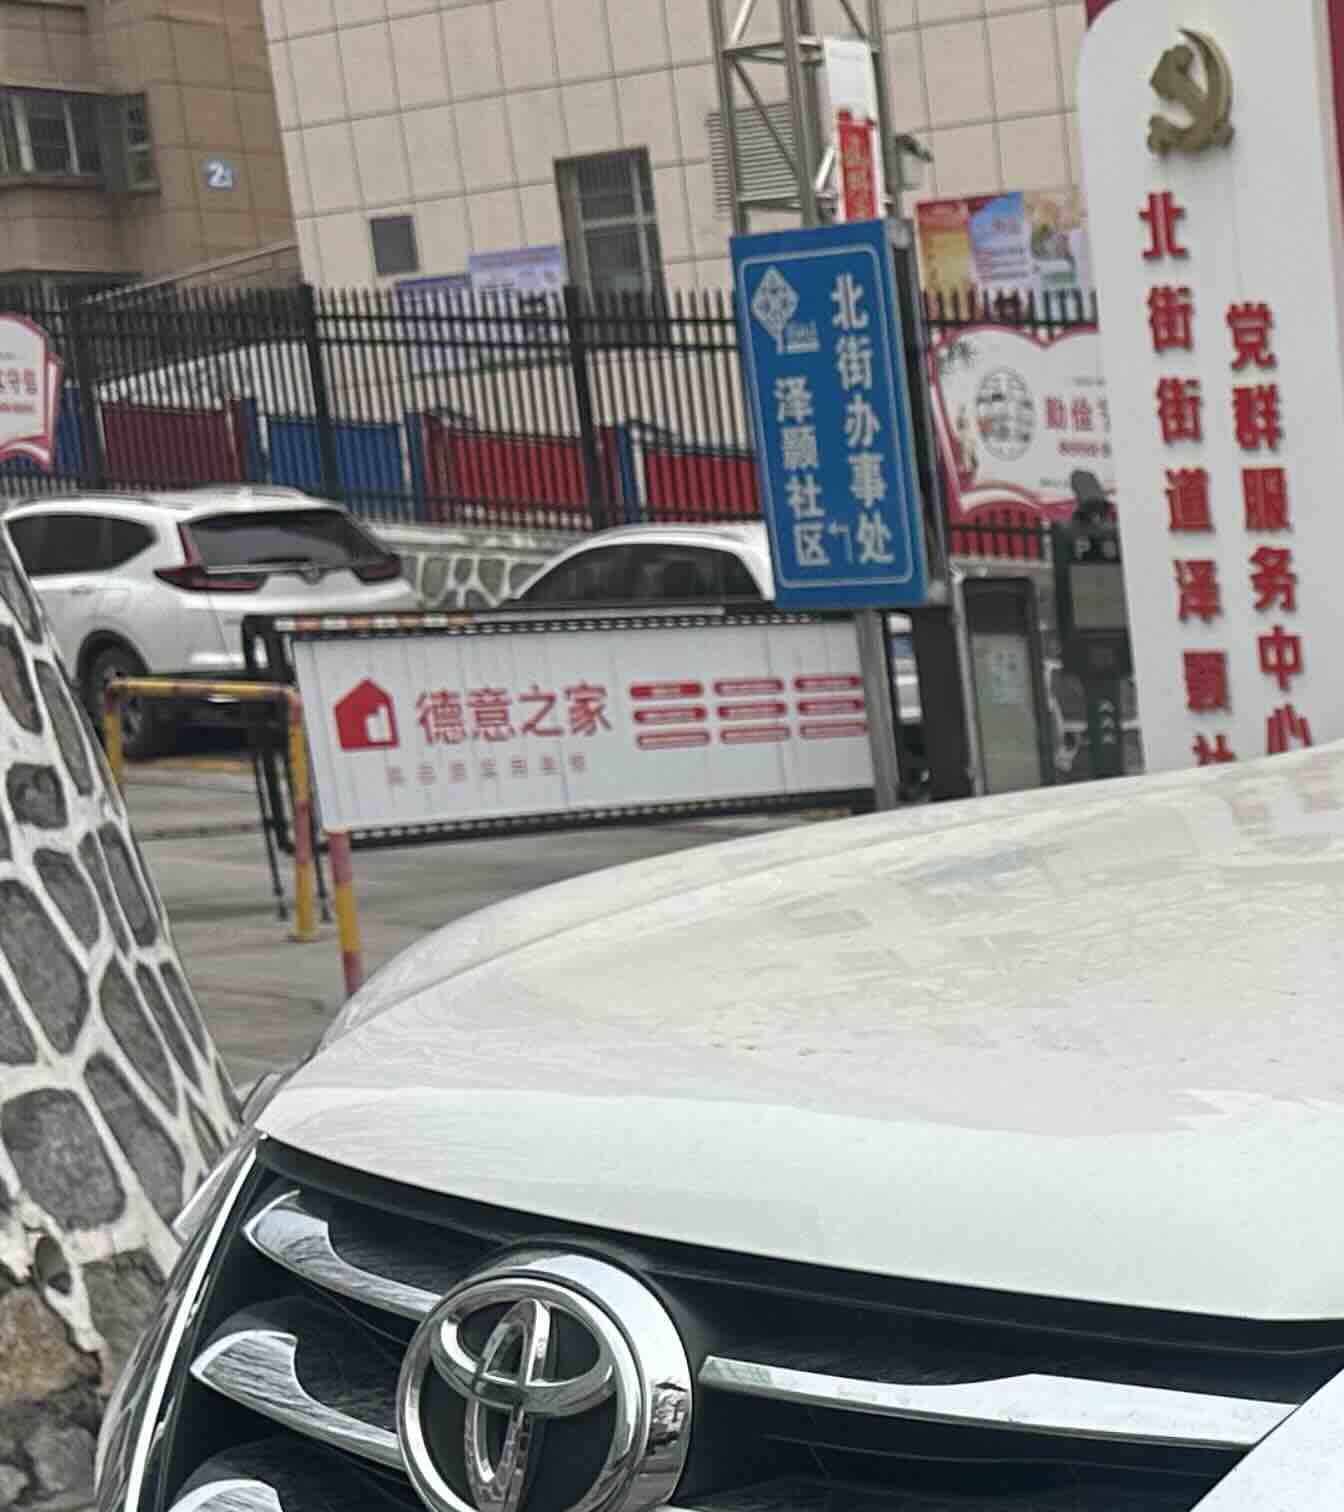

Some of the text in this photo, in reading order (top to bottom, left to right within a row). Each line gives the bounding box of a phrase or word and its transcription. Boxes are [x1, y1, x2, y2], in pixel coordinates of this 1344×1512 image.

[831, 273, 895, 565] 北街办事处
[1226, 303, 1313, 753] 党群服务中心
[415, 680, 613, 745] 德意之家
